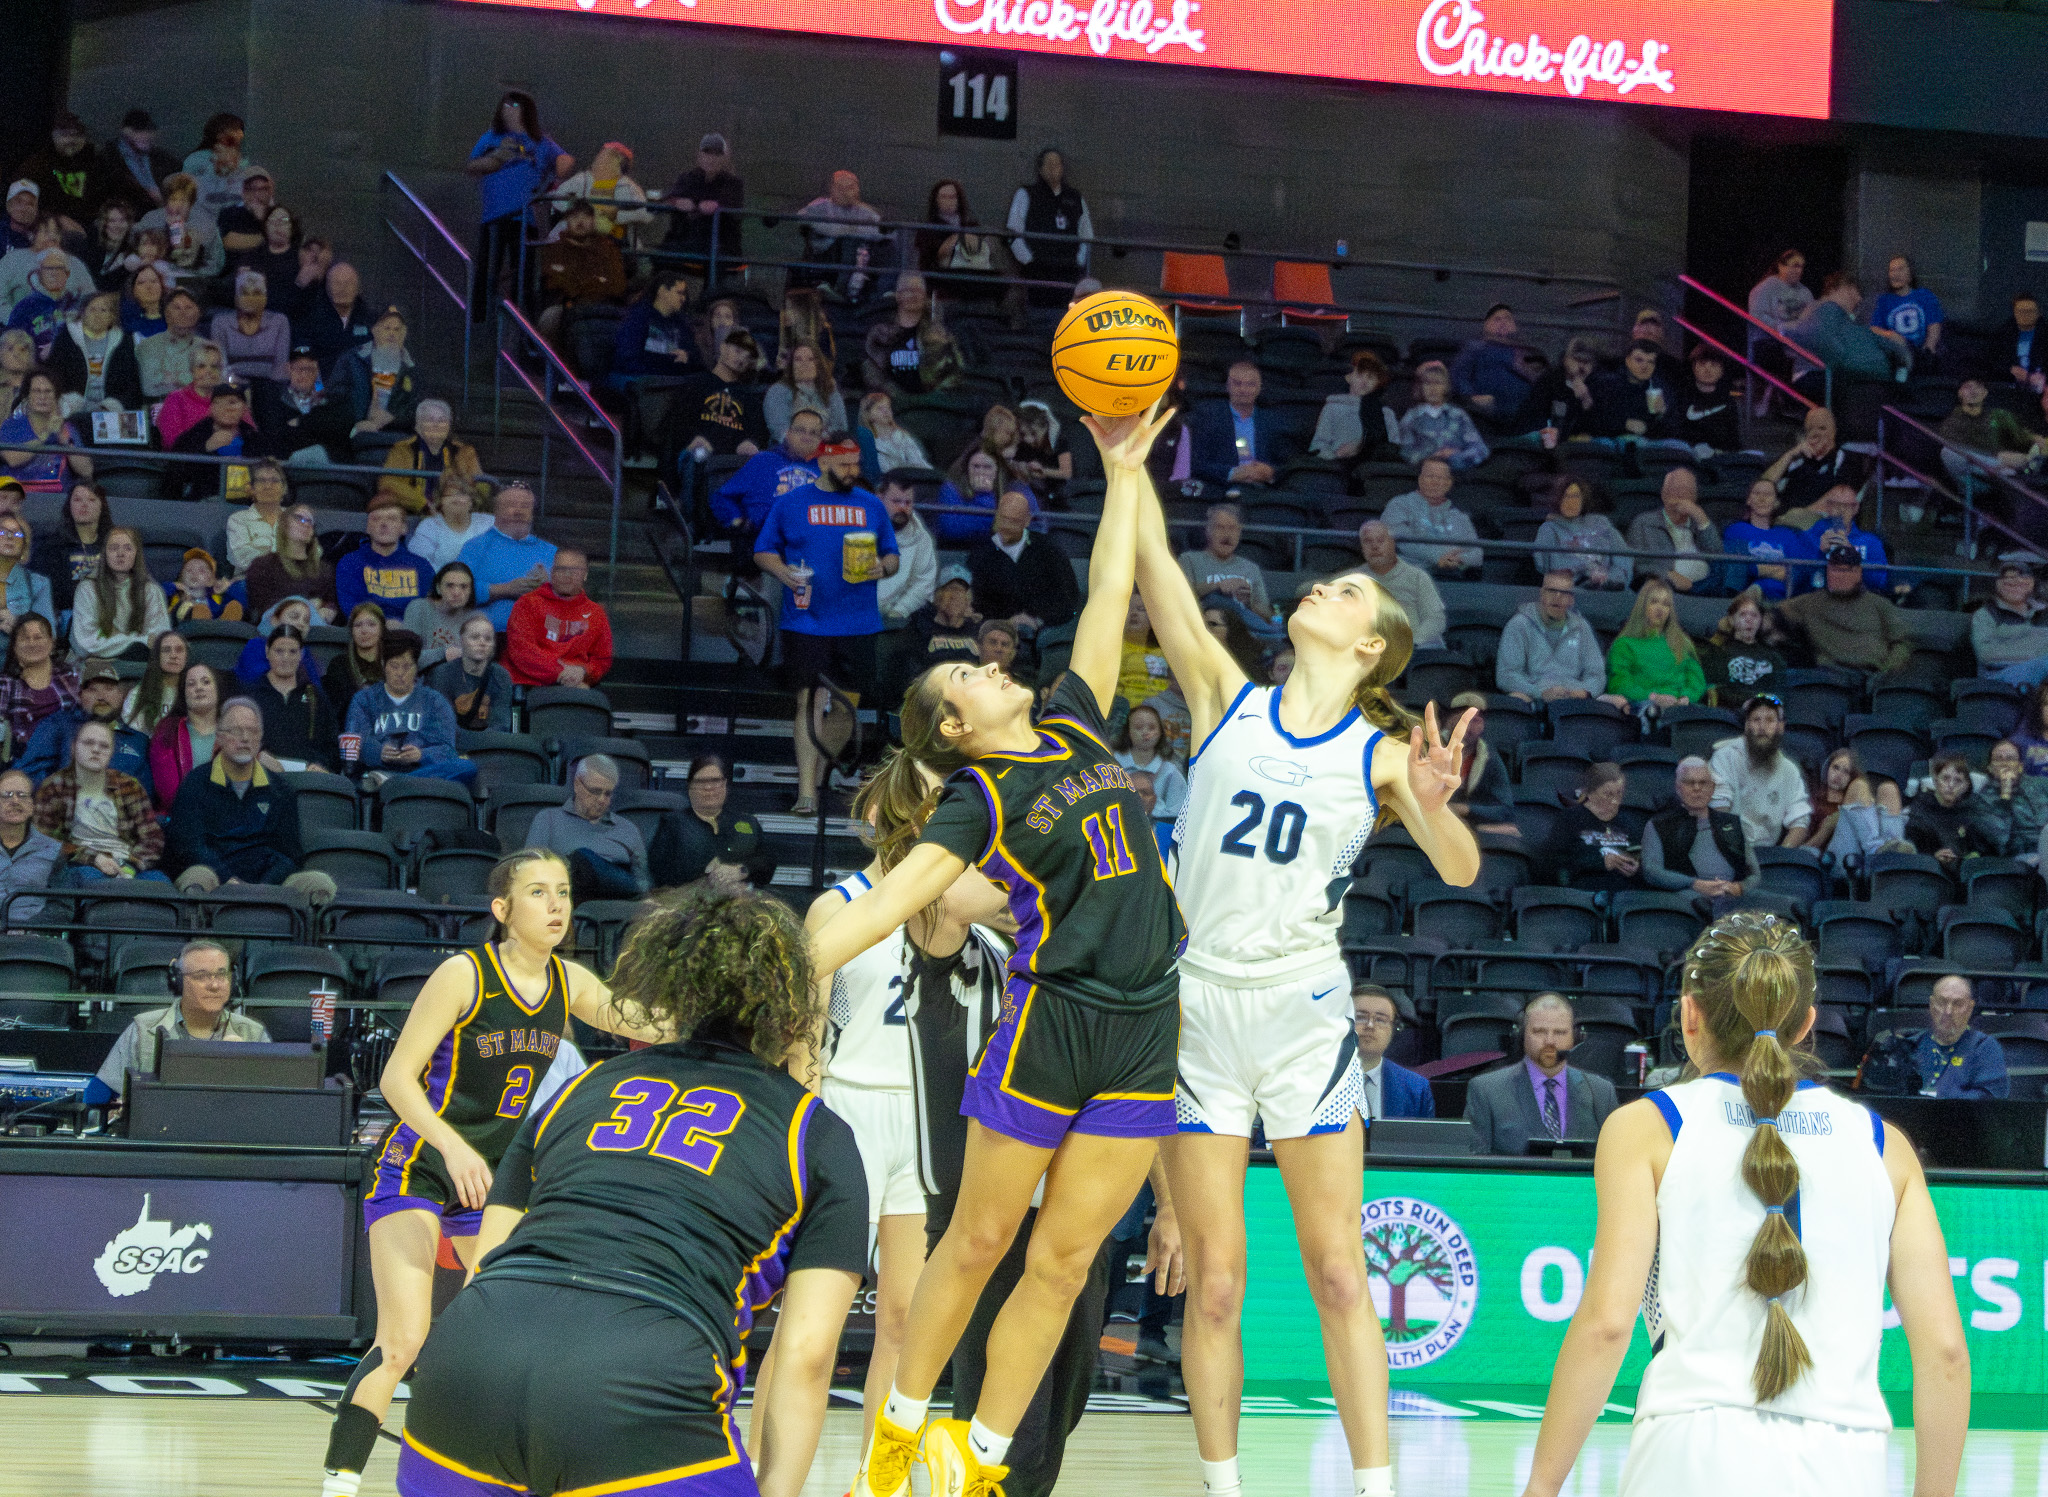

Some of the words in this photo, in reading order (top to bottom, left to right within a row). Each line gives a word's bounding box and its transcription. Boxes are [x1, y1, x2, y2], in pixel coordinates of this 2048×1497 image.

[1416, 0, 1676, 96] Chick-fil-A
[949, 71, 1010, 122] 114
[1084, 307, 1169, 334] Wilson
[1106, 353, 1157, 371] EVO
[1026, 794, 1063, 835] ST
[1220, 789, 1308, 866] 20
[1081, 803, 1138, 882] 11
[476, 1031, 504, 1058] ST
[510, 1028, 560, 1058] MARY
[495, 1064, 534, 1119] 2
[1724, 1101, 1758, 1128] LAD
[585, 1075, 746, 1176] 32
[112, 1245, 209, 1275] SSAC
[1361, 1200, 1404, 1226] OTS
[1411, 1203, 1450, 1235] RUN
[1448, 1234, 1474, 1287] DEEP
[1387, 1349, 1422, 1366] LTH
[1425, 1319, 1462, 1357] PLAN
